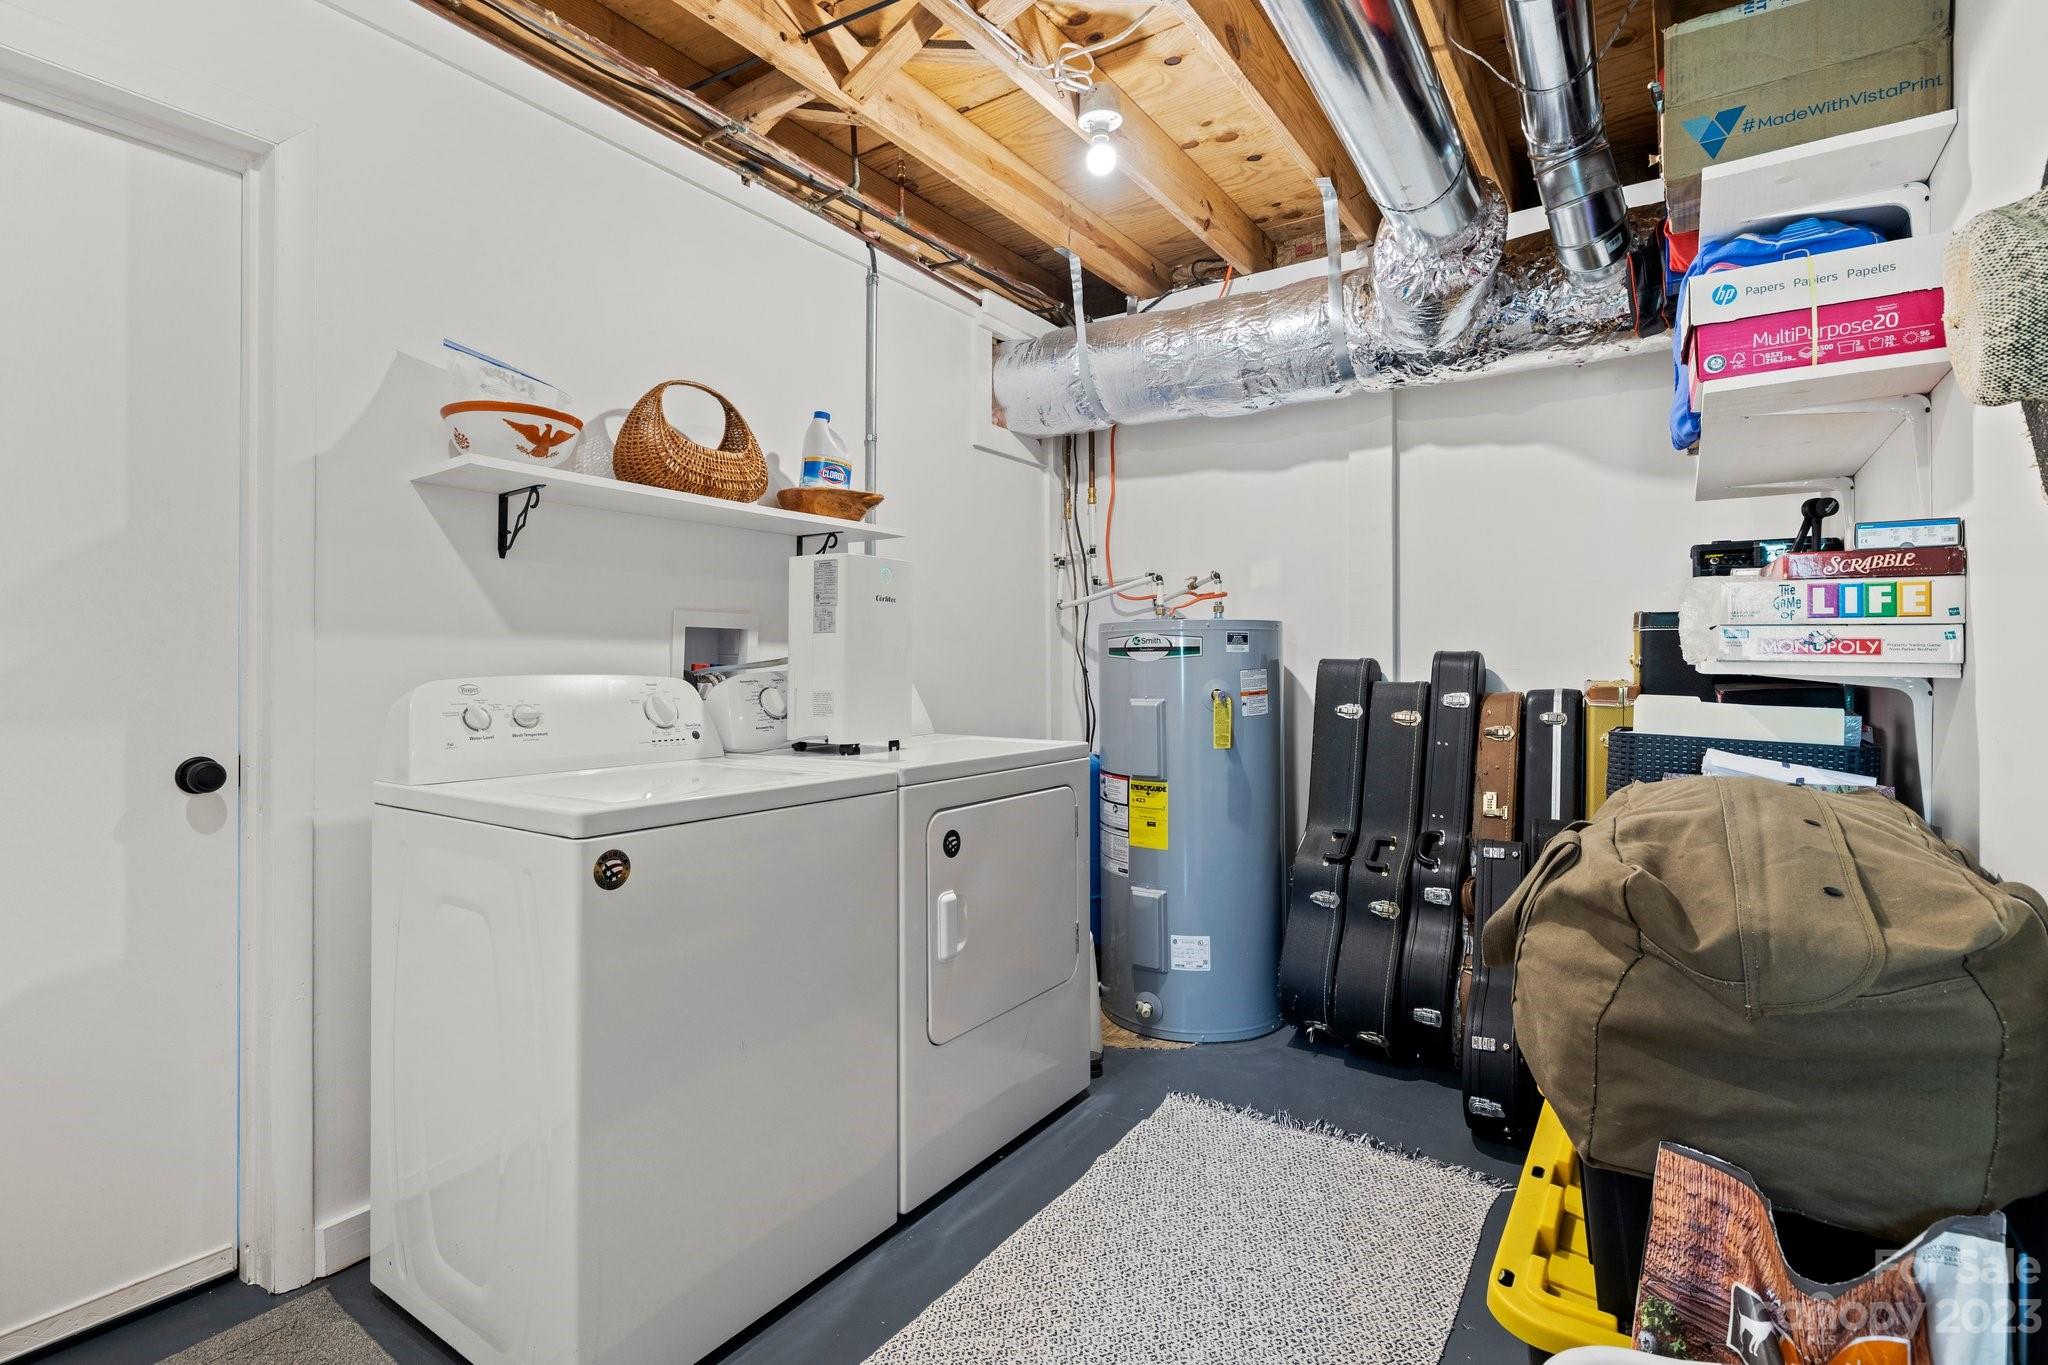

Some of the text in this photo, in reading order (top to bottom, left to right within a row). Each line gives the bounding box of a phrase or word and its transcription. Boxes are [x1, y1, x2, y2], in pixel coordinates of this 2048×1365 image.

[1741, 74, 1944, 134] #MadeWithVistaPrint
[1745, 282, 1785, 296] Papers
[1846, 262, 1897, 279] Papeles
[1713, 284, 1737, 305] hp
[1753, 312, 1900, 347] MultiPurpose20
[822, 469, 845, 481] CLOROX
[1822, 552, 1916, 576] SCRABBLE
[1811, 584, 1928, 616] LIFE
[1141, 637, 1161, 645] Smith
[1760, 638, 1881, 655] MONOPOLY
